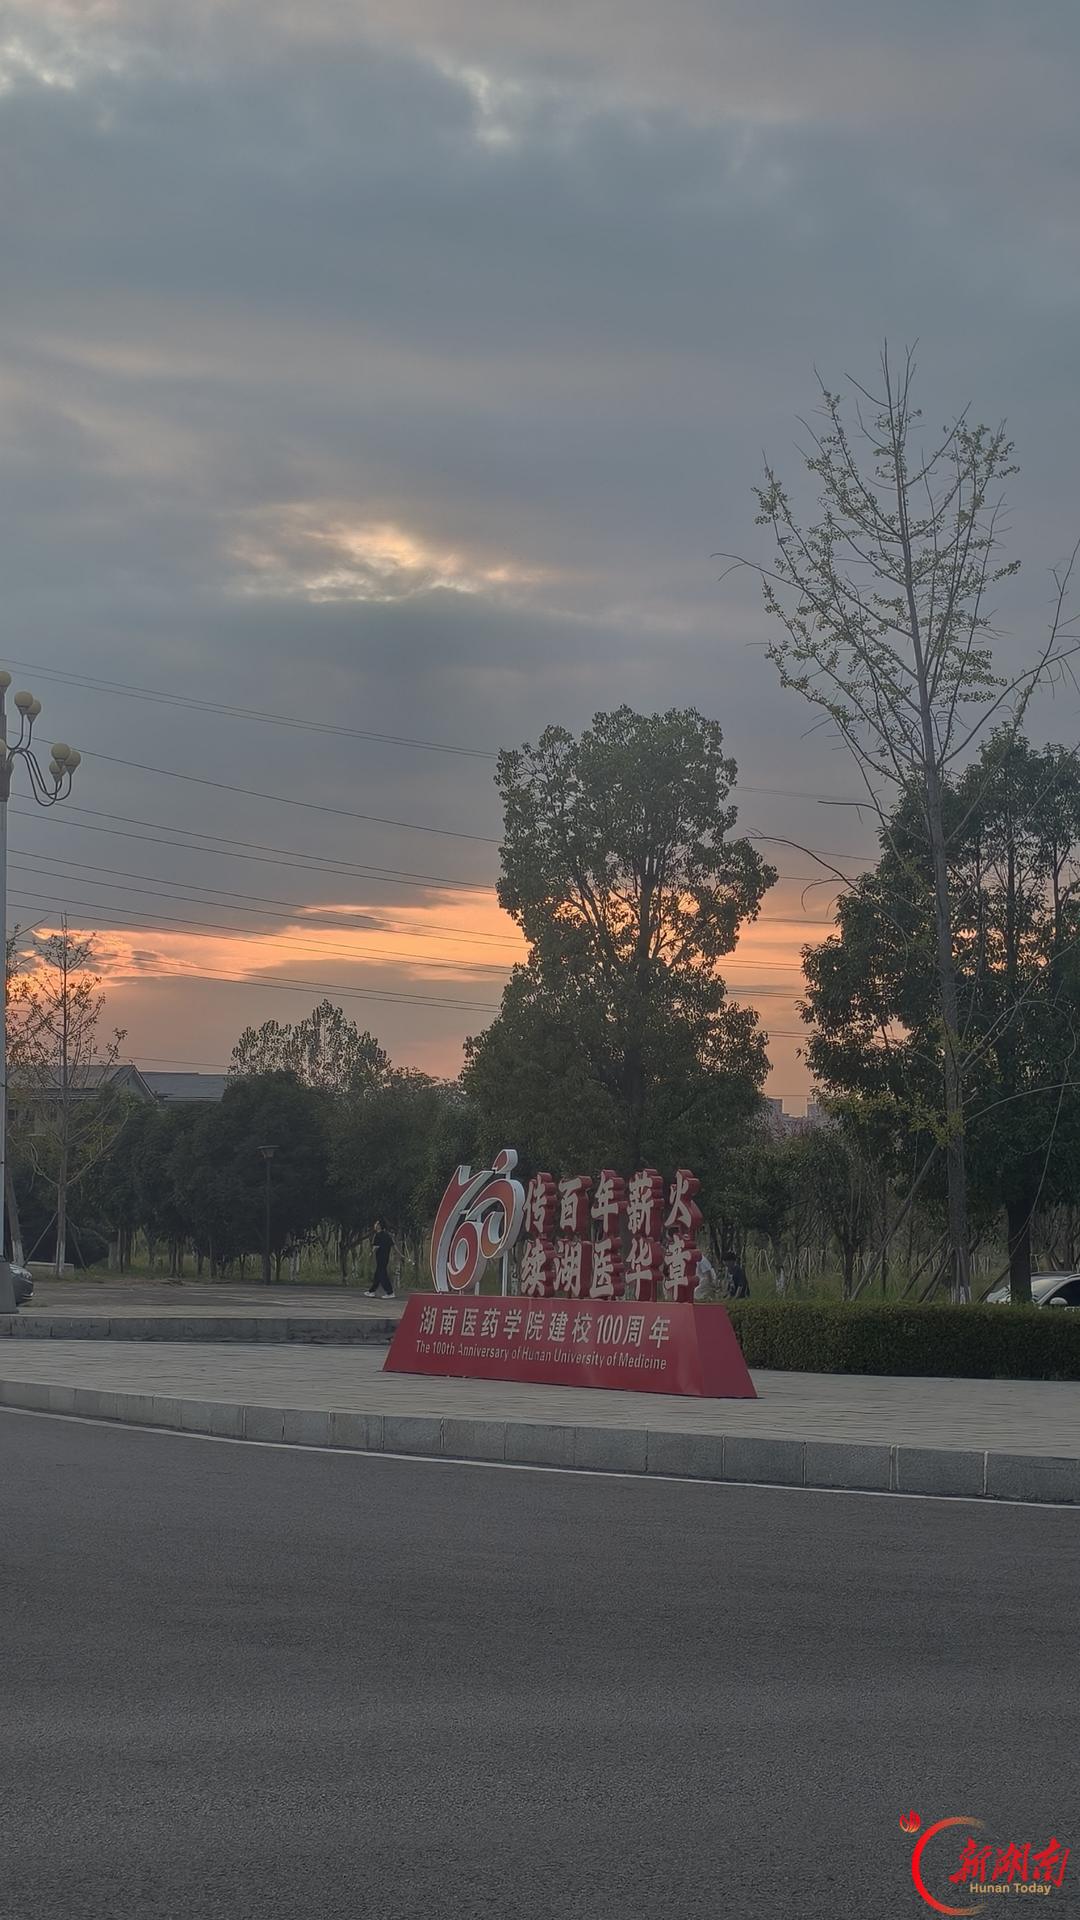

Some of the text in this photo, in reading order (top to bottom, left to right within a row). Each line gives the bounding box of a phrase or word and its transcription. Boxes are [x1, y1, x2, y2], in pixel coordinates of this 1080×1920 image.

[522, 1170, 698, 1235] 传百年薪火
[520, 1235, 693, 1301] 续湖医华章
[419, 1305, 671, 1349] 湖南医药学院建校100周年
[416, 1340, 667, 1370] The 100th Anniversary of Hunan University of Medicine
